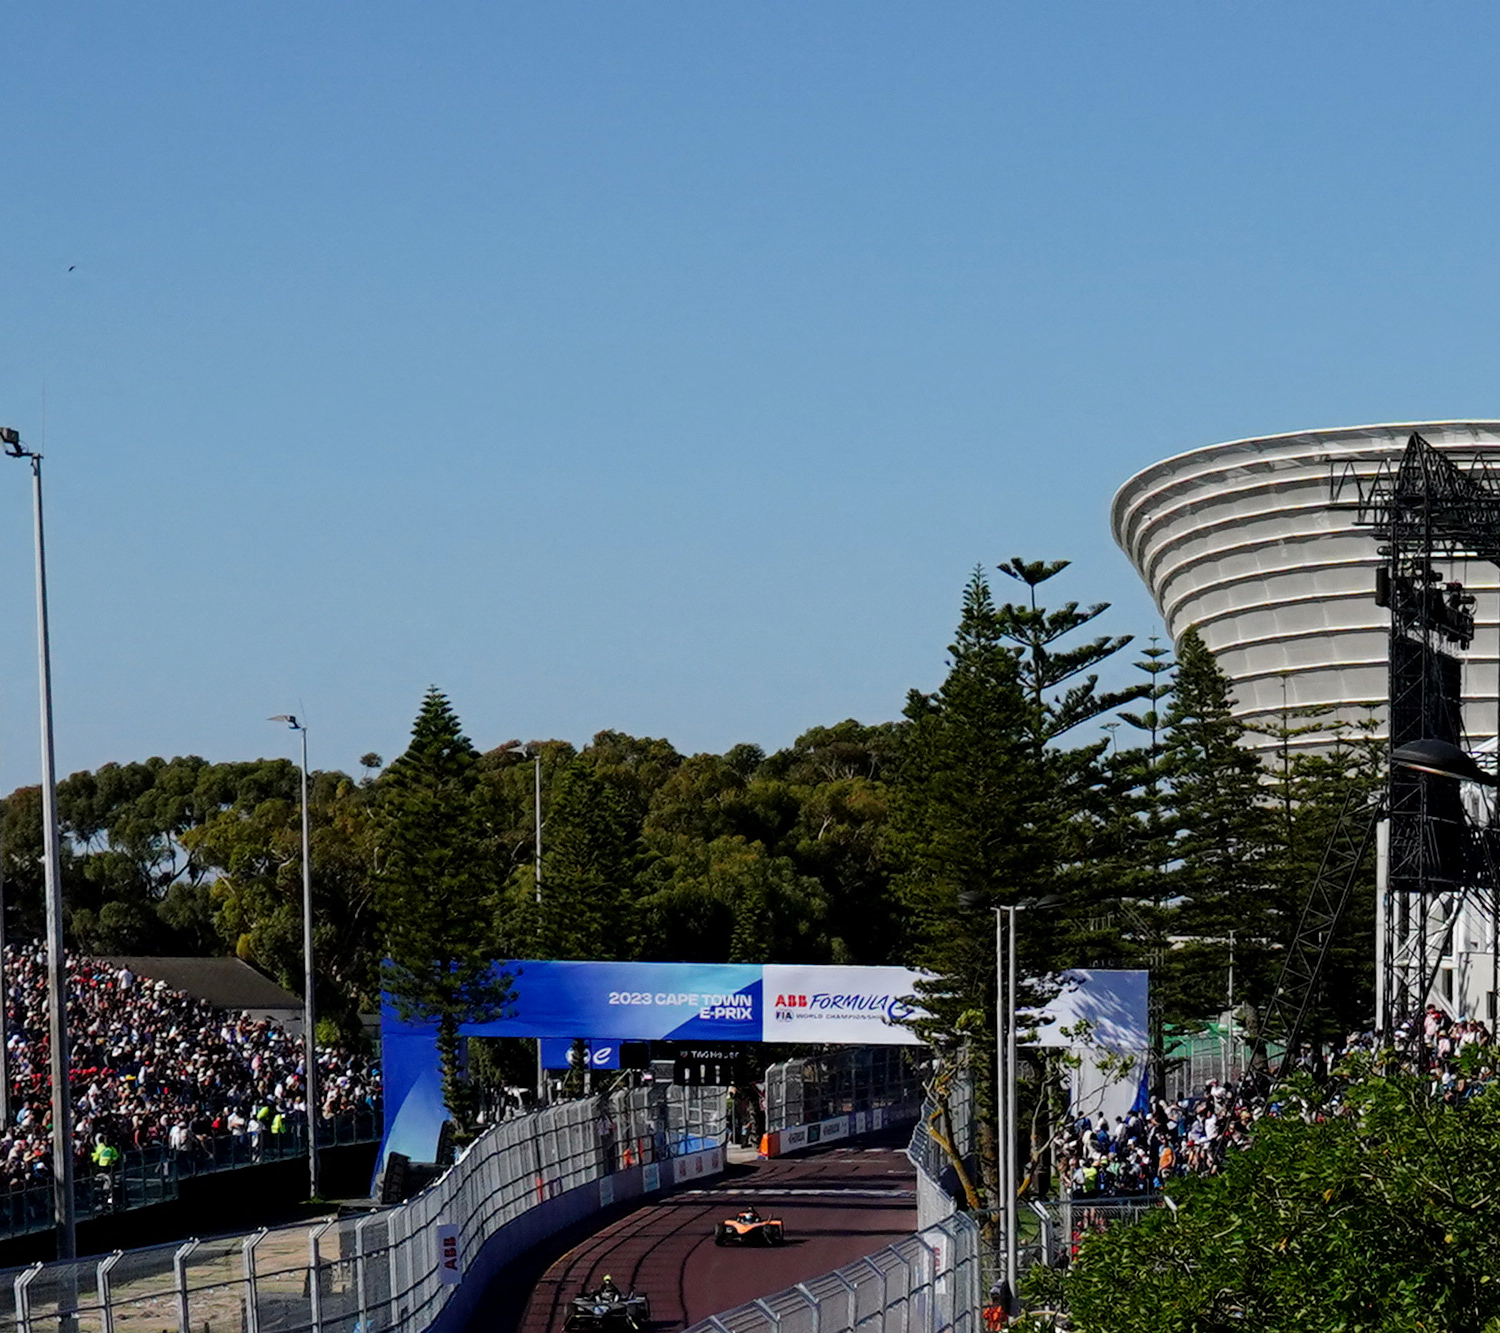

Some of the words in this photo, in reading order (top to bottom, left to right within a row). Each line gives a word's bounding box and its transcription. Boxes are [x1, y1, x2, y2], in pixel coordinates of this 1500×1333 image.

[609, 991, 652, 1005] 2023
[655, 992, 698, 1006] CAPE
[701, 994, 752, 1007] TOWN
[775, 994, 808, 1007] ABB
[809, 993, 890, 1011] FORMULA
[700, 1007, 752, 1020] E-PRIX
[444, 1236, 458, 1271] ABB
